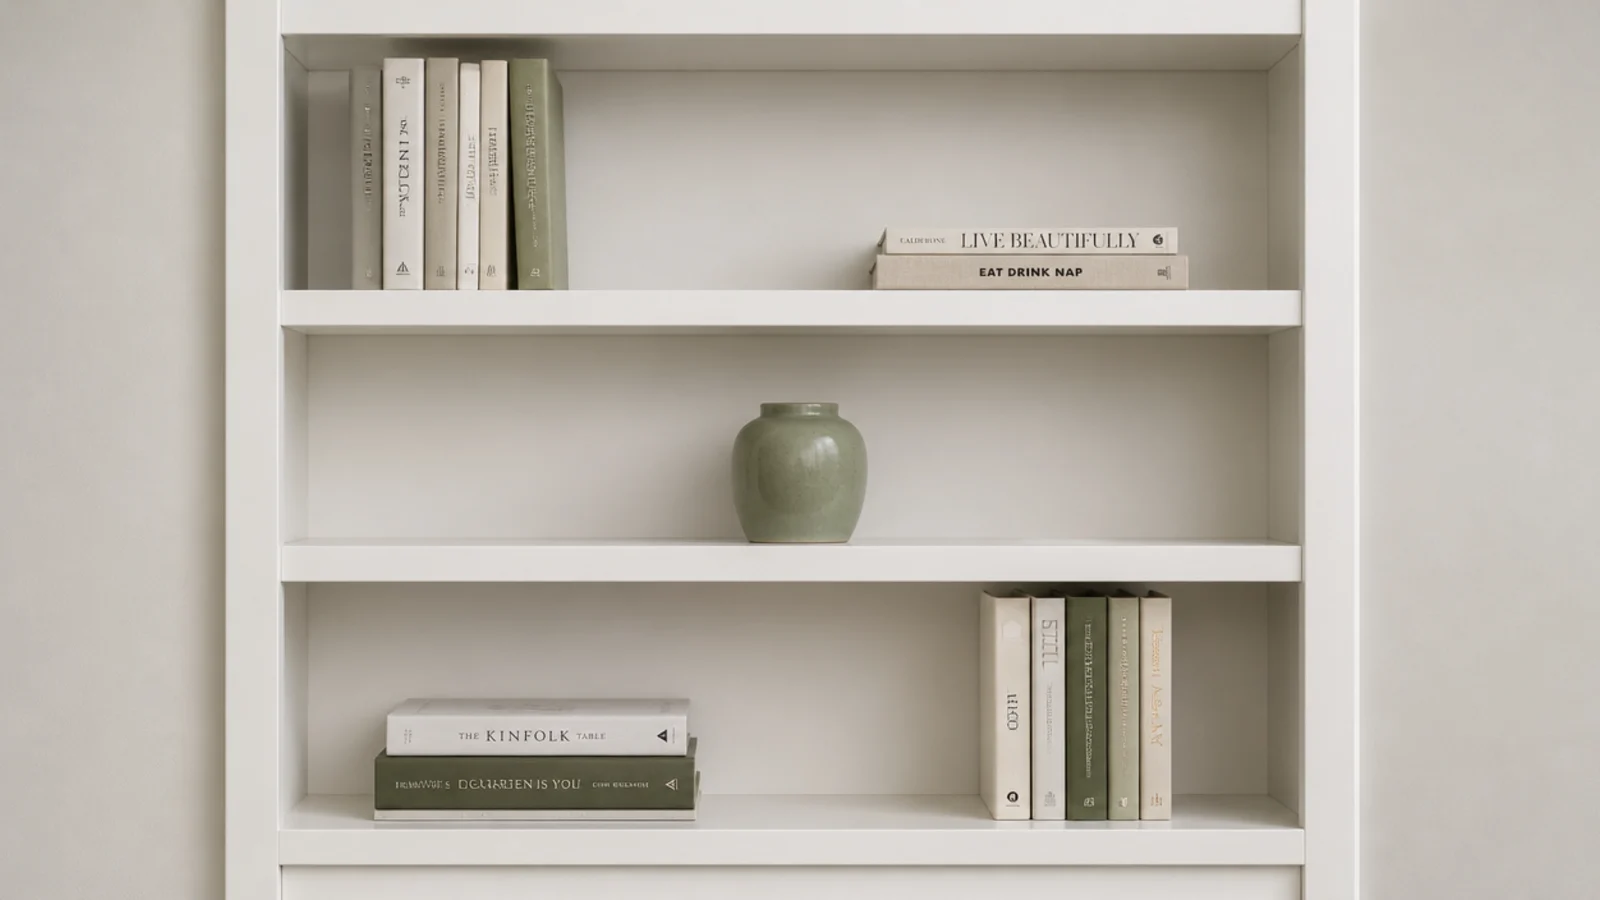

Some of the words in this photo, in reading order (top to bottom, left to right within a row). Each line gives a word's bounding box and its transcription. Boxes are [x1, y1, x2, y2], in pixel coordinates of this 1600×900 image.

[961, 232, 1005, 249] LIVE
[1011, 232, 1139, 249] BEAUTIFULLY
[979, 267, 1003, 277] EAT
[1008, 267, 1051, 277] DRINK
[1055, 267, 1083, 277] NAP
[458, 732, 480, 740] THE
[486, 730, 571, 742] KINFOLK
[576, 732, 606, 740] TABLE
[536, 779, 548, 790] IS
[551, 779, 581, 790] YOU
